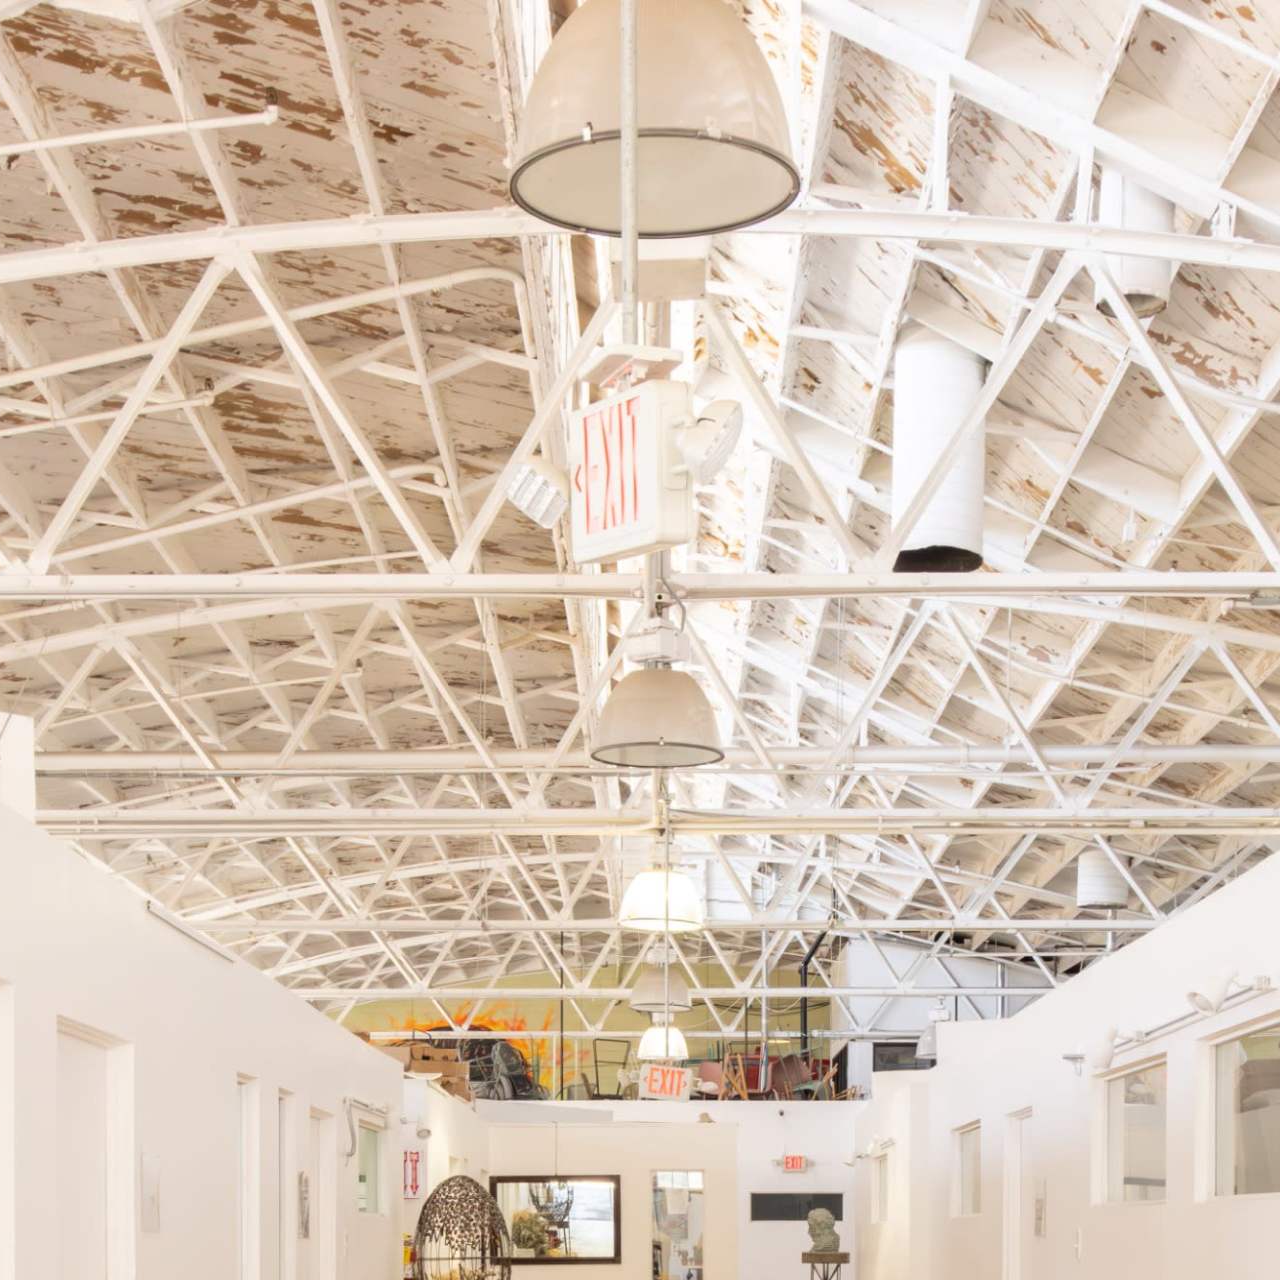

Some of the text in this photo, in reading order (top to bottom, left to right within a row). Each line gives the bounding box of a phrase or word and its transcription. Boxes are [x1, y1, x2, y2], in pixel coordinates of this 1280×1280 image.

[583, 395, 640, 534] EXIT
[648, 1066, 686, 1097] EXIT
[785, 1156, 803, 1169] EXIT
